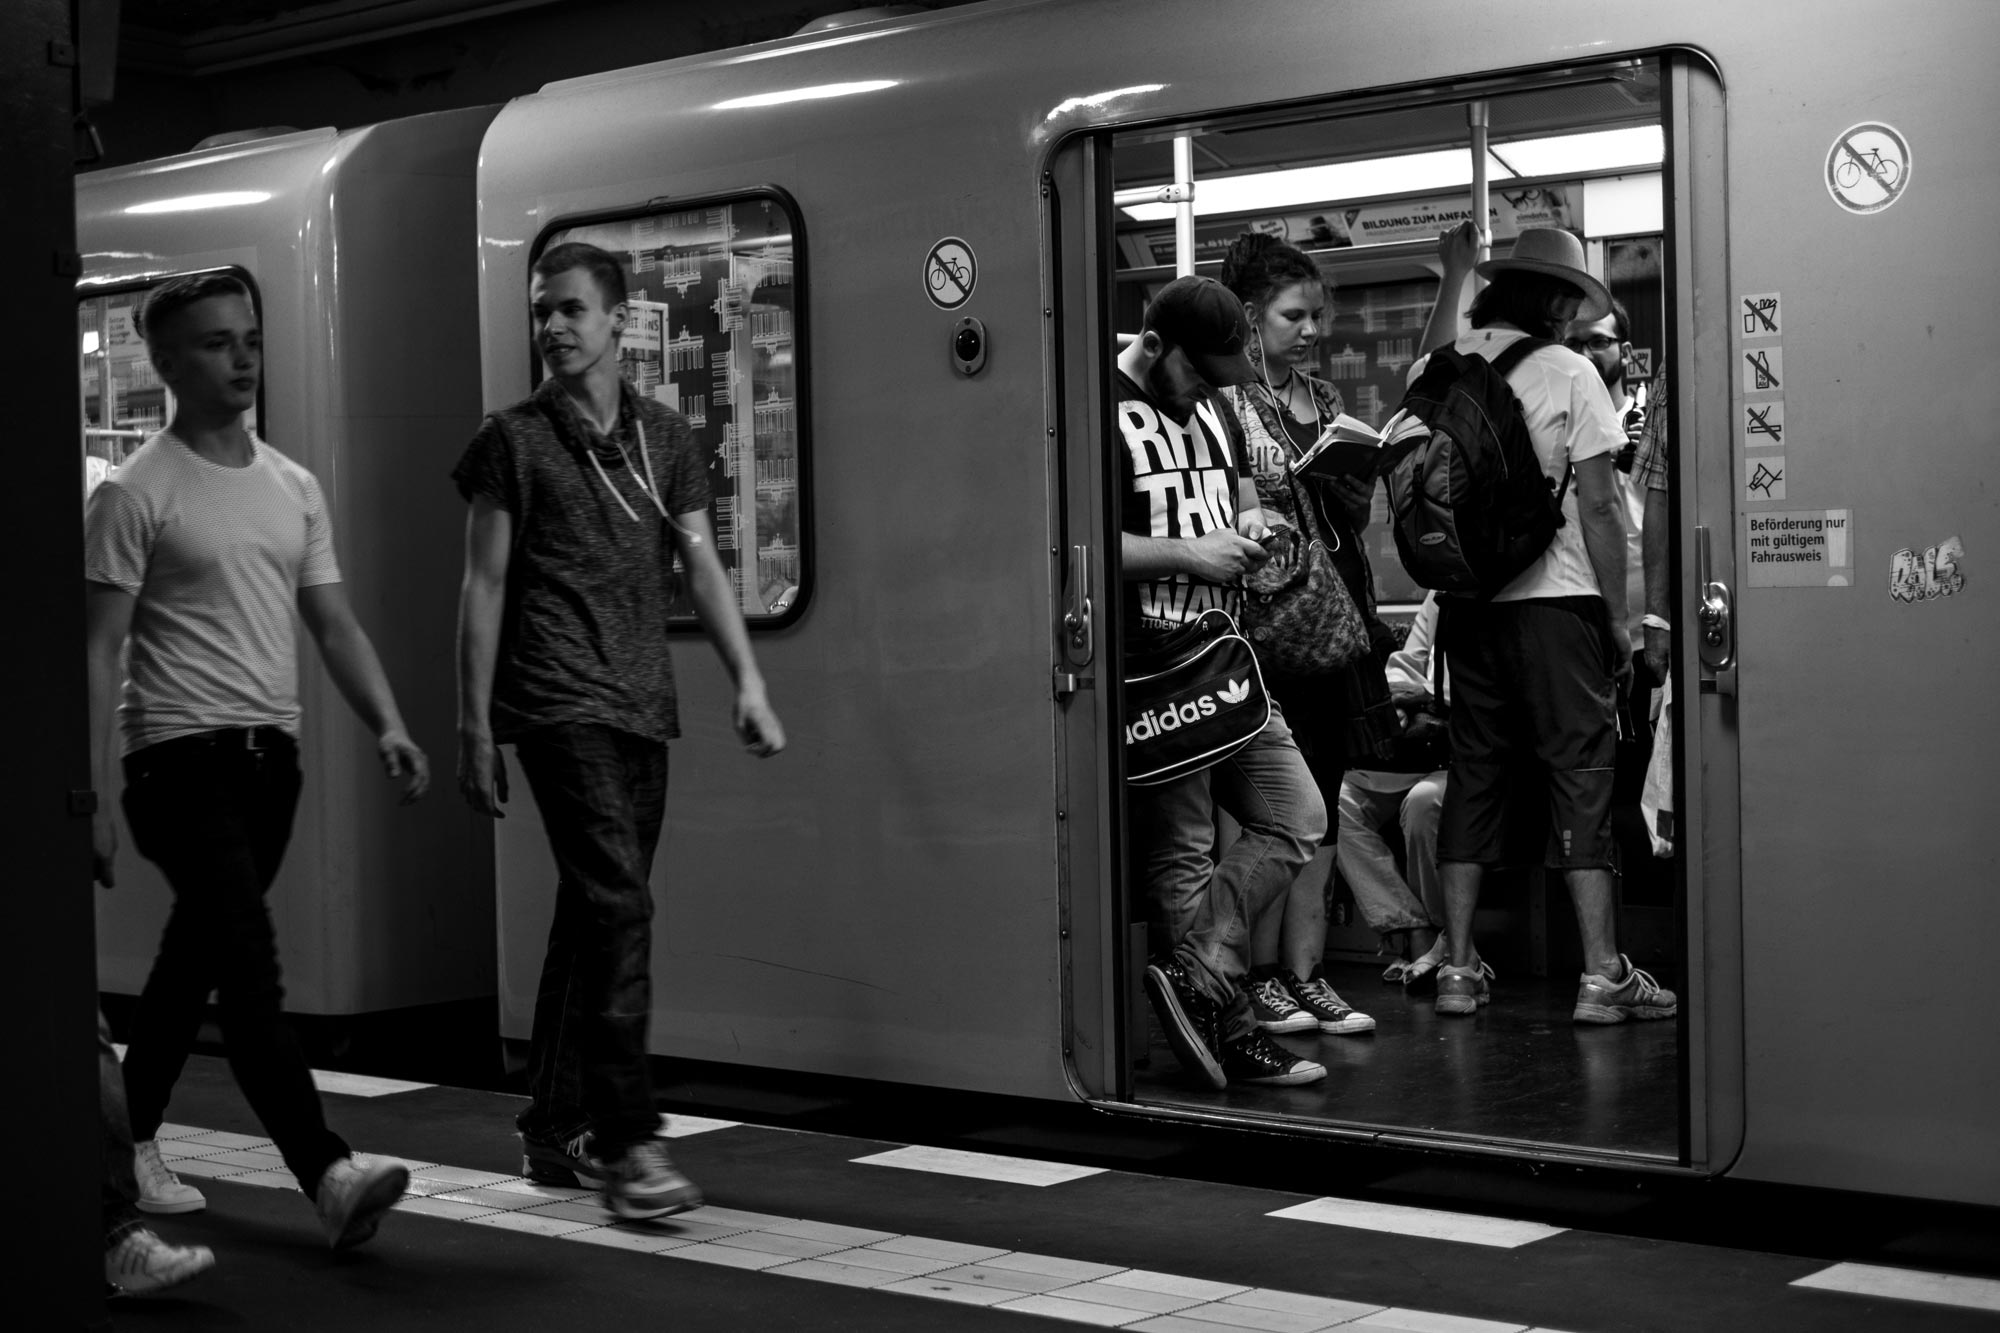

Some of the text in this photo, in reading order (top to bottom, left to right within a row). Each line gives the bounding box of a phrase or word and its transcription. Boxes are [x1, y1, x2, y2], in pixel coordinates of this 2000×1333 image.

[1362, 215, 1411, 230] BILDUNG
[1412, 213, 1437, 225] ZUM
[1438, 207, 1498, 224] ANFASN
[1750, 517, 1846, 532] Beförderung nur
[1750, 534, 1825, 549] mit gültigem
[1751, 549, 1822, 563] Fahrausweis
